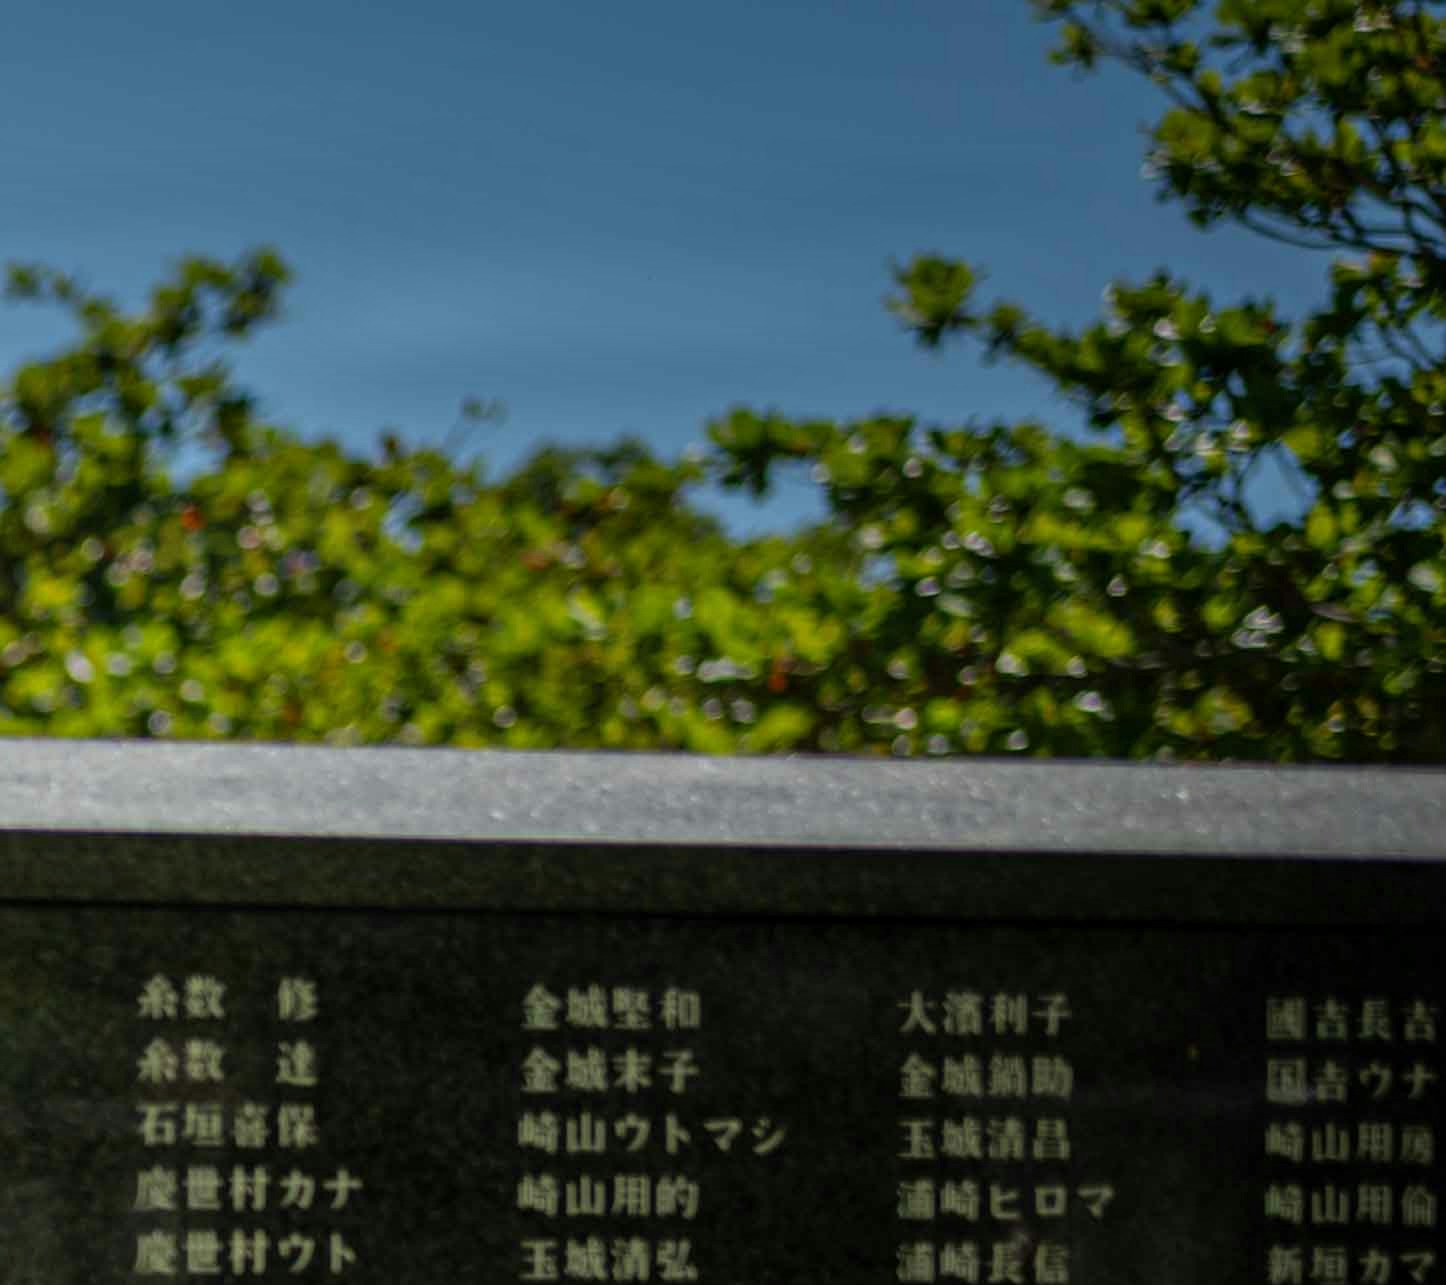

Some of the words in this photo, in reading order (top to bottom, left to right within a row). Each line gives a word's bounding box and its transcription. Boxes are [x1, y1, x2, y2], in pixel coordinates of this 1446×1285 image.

[900, 1117, 1071, 1160] 玉城清昌
[135, 1166, 364, 1210] 慶世村カナ
[135, 1230, 357, 1274] 慶世村ウト
[521, 1238, 699, 1281] 玉城清弘
[1268, 1244, 1435, 1285] 新垣カマ
